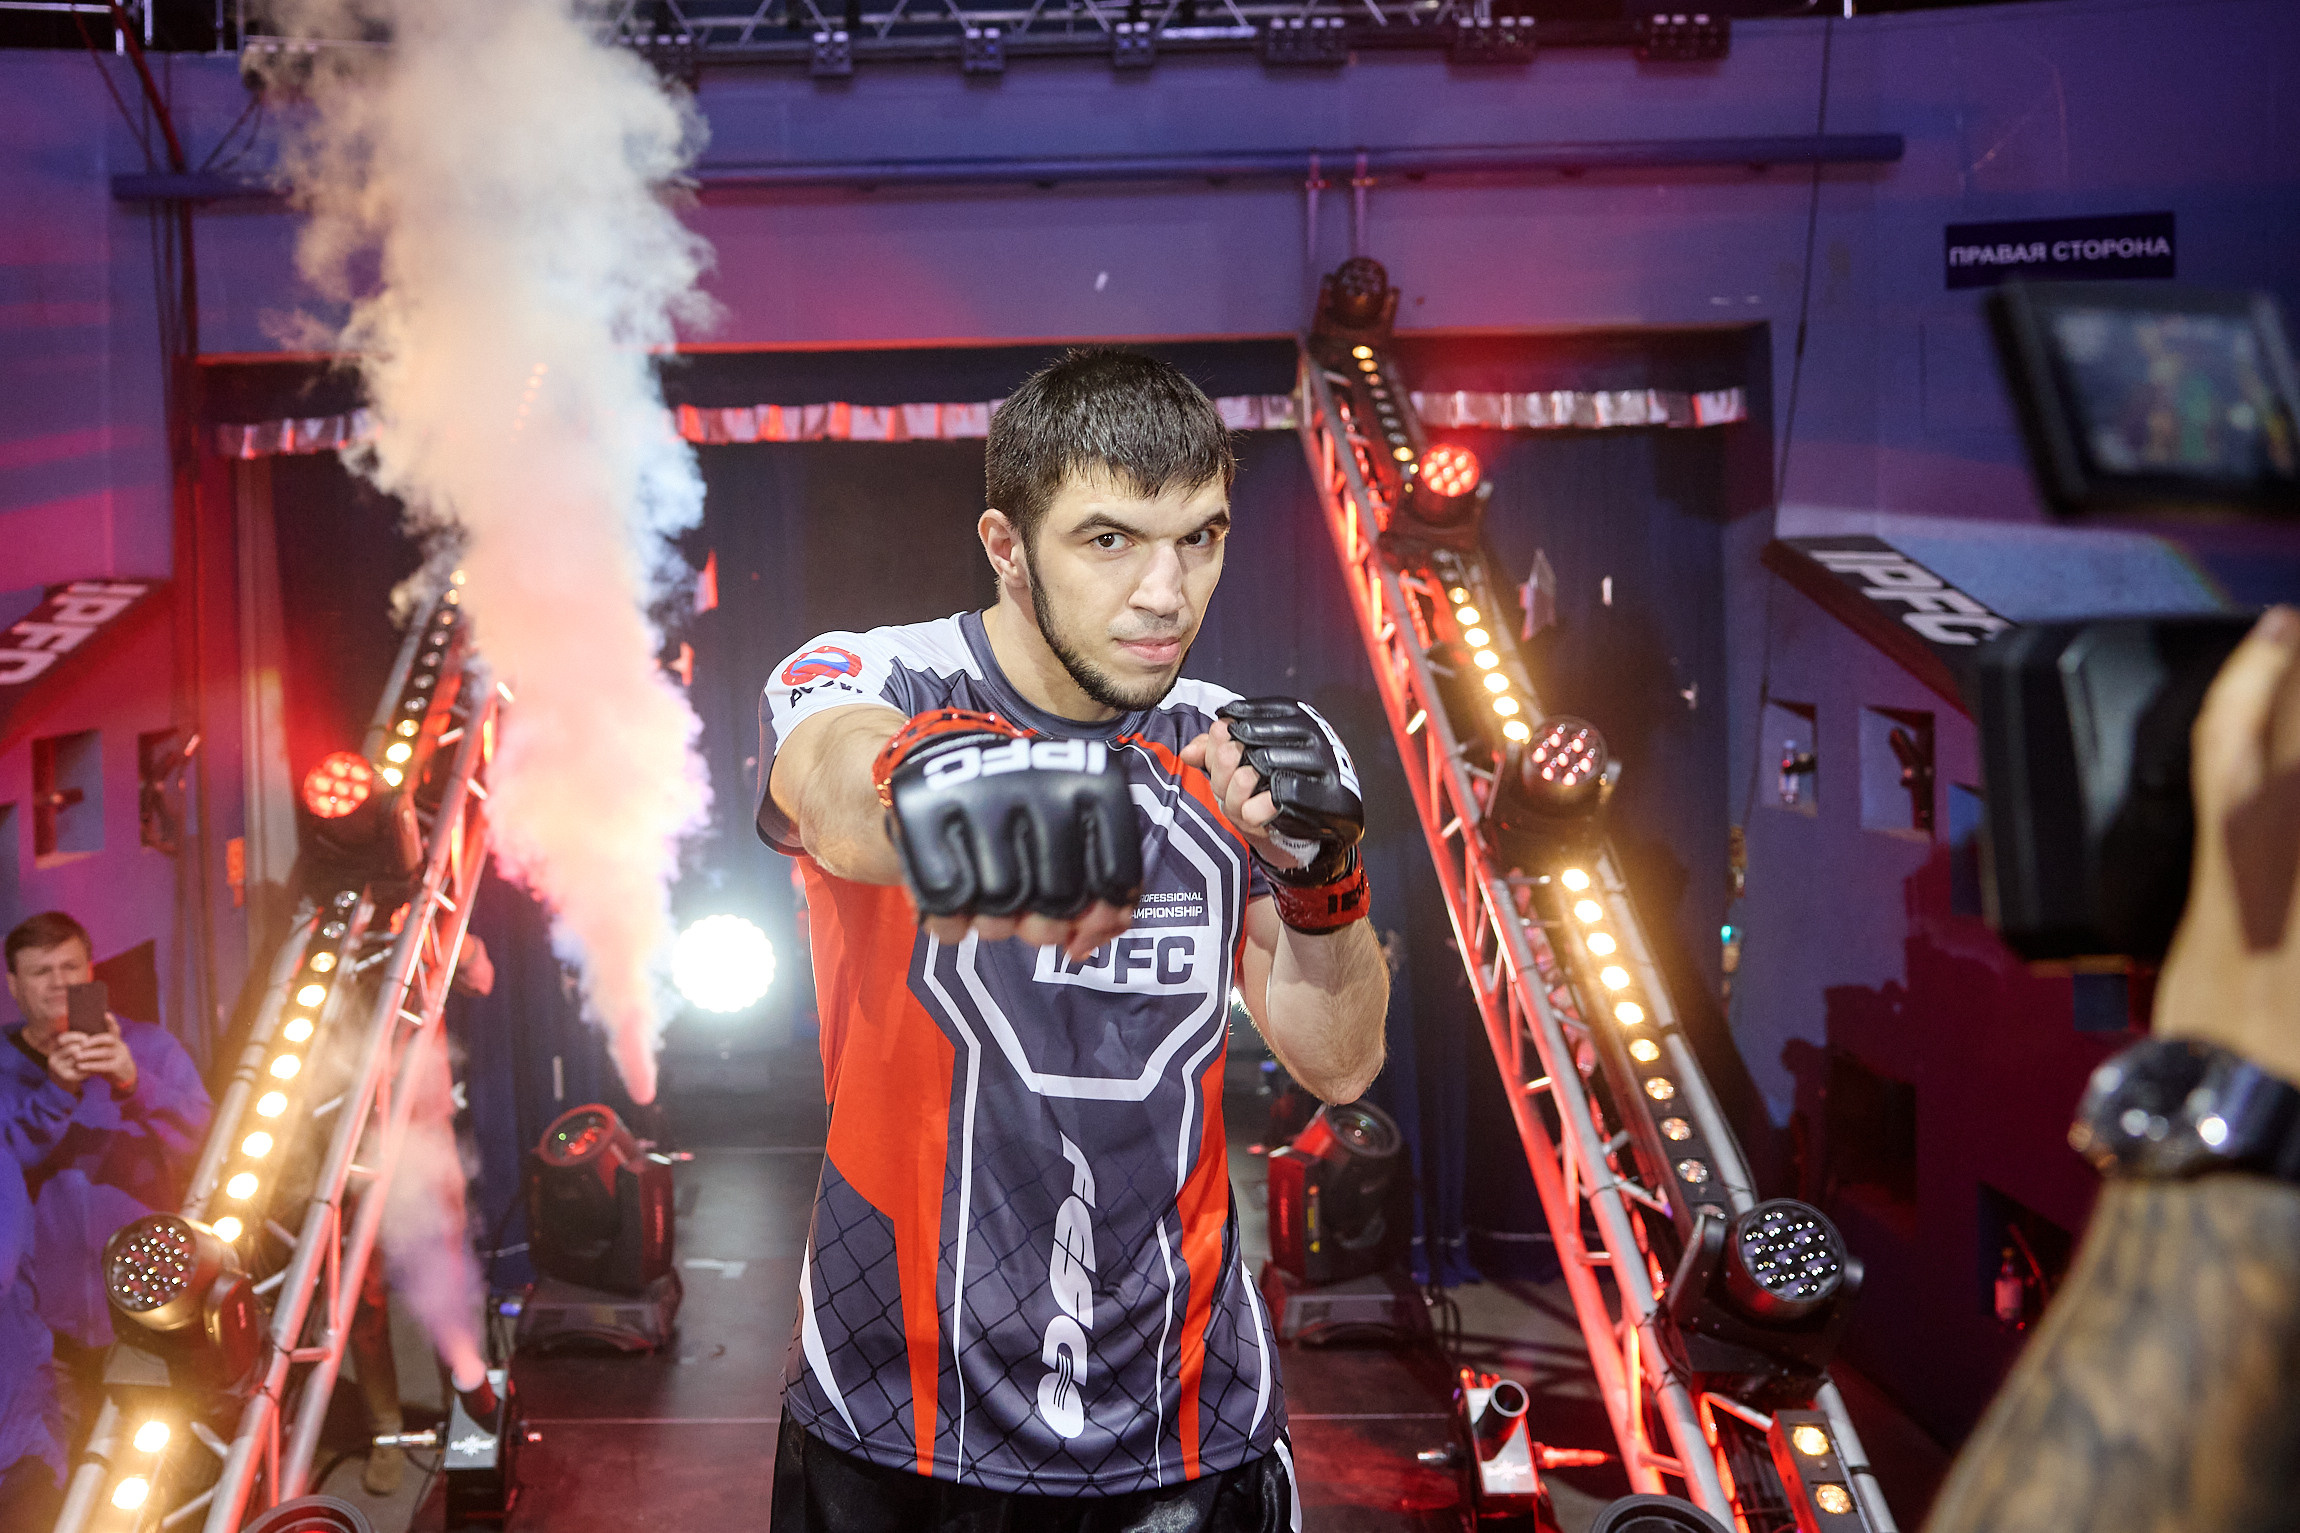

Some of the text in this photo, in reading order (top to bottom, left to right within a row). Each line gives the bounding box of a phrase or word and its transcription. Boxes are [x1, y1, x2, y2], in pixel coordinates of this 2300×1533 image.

[1950, 236, 2171, 267] ПРАВАЯ СТОРОНА
[1808, 551, 2011, 645] IPFC
[923, 738, 1107, 790] IPFC
[1131, 905, 1203, 919] AMPIONSHIP
[1140, 892, 1203, 903] ROFESSIONAL
[1037, 1130, 1096, 1439] FESCO
